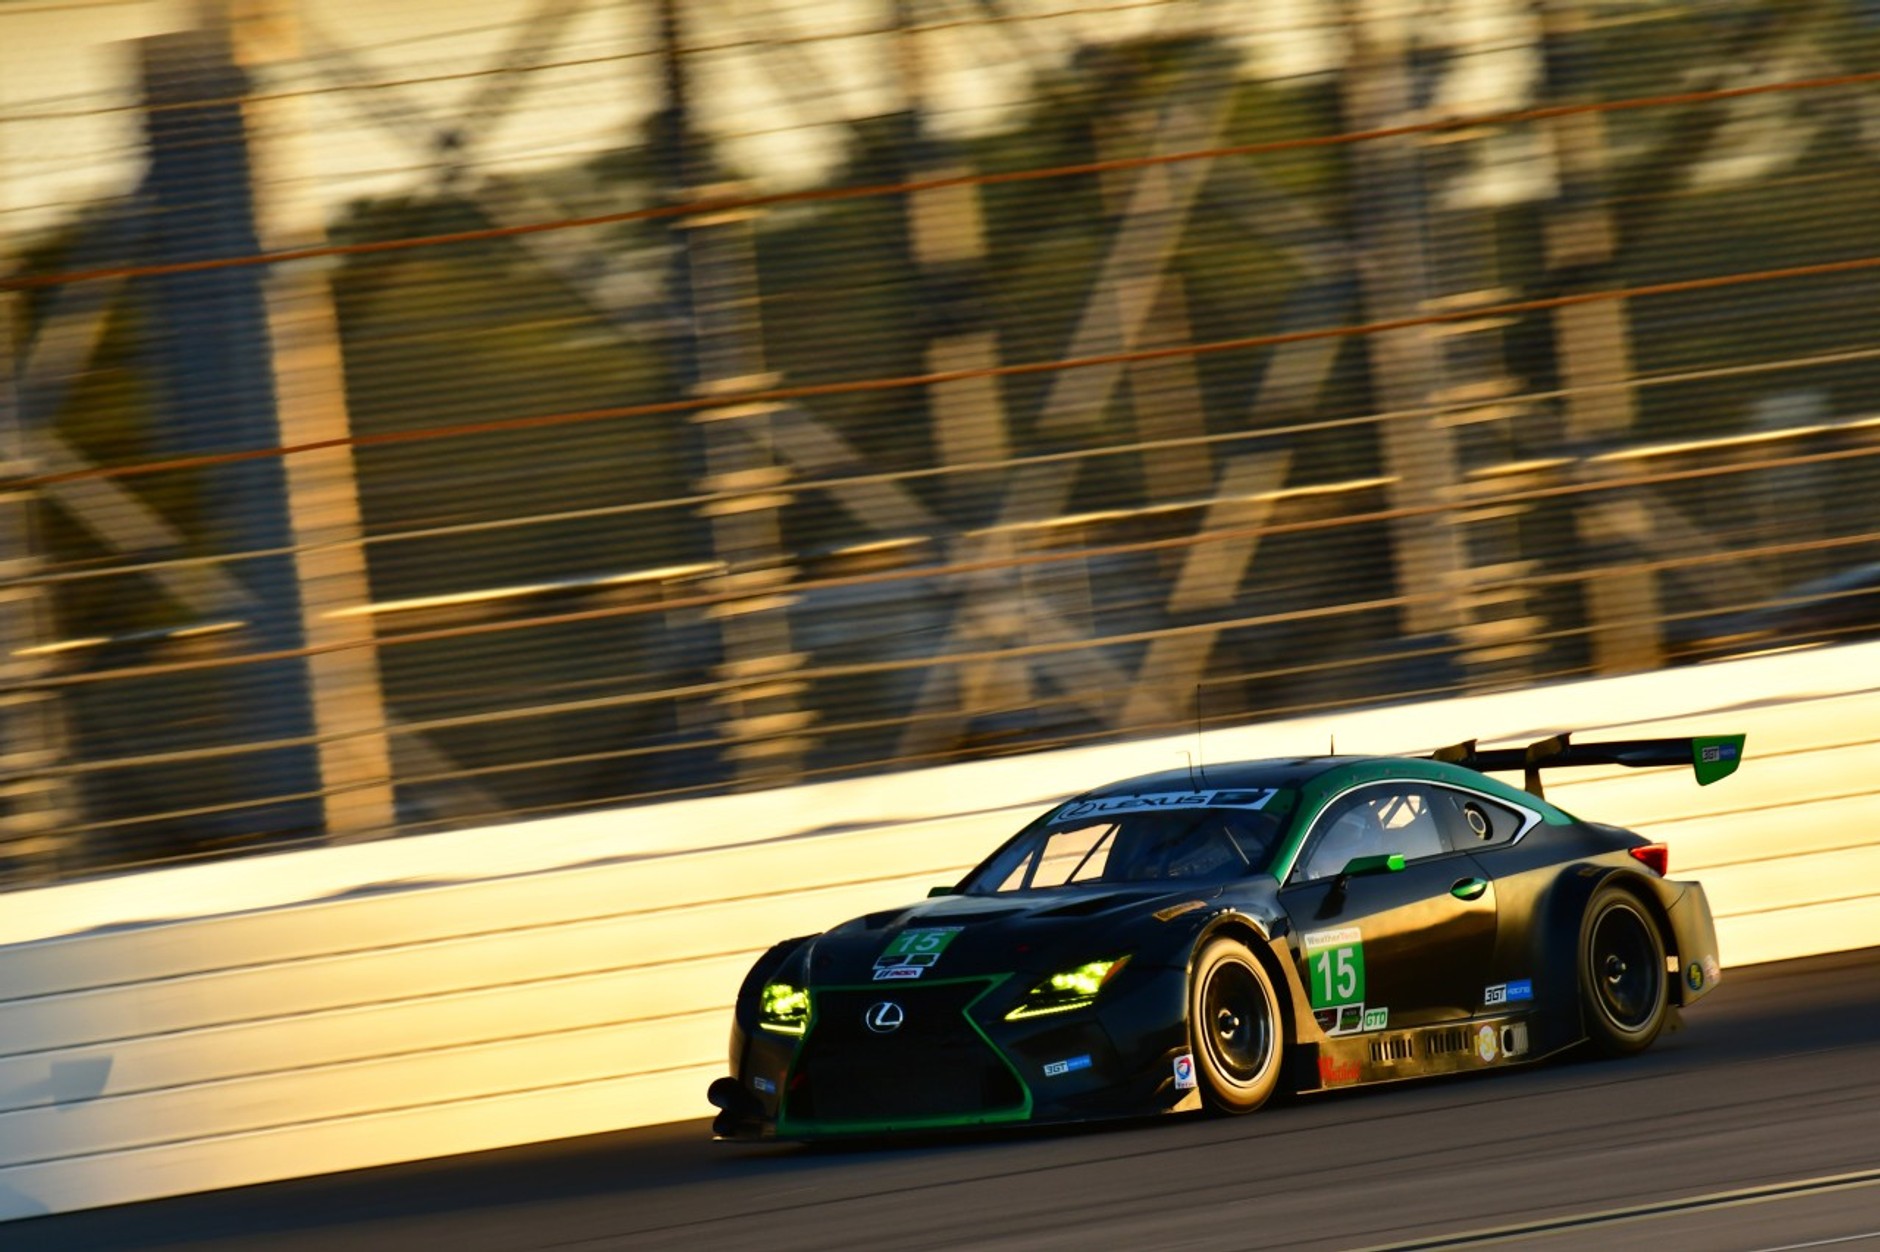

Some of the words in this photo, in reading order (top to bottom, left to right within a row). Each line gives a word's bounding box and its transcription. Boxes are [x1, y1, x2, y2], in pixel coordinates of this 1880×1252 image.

[1097, 795, 1207, 811] LEXUS
[900, 932, 945, 952] 15
[1317, 947, 1356, 1001] 15
[1366, 1011, 1386, 1027] GTD
